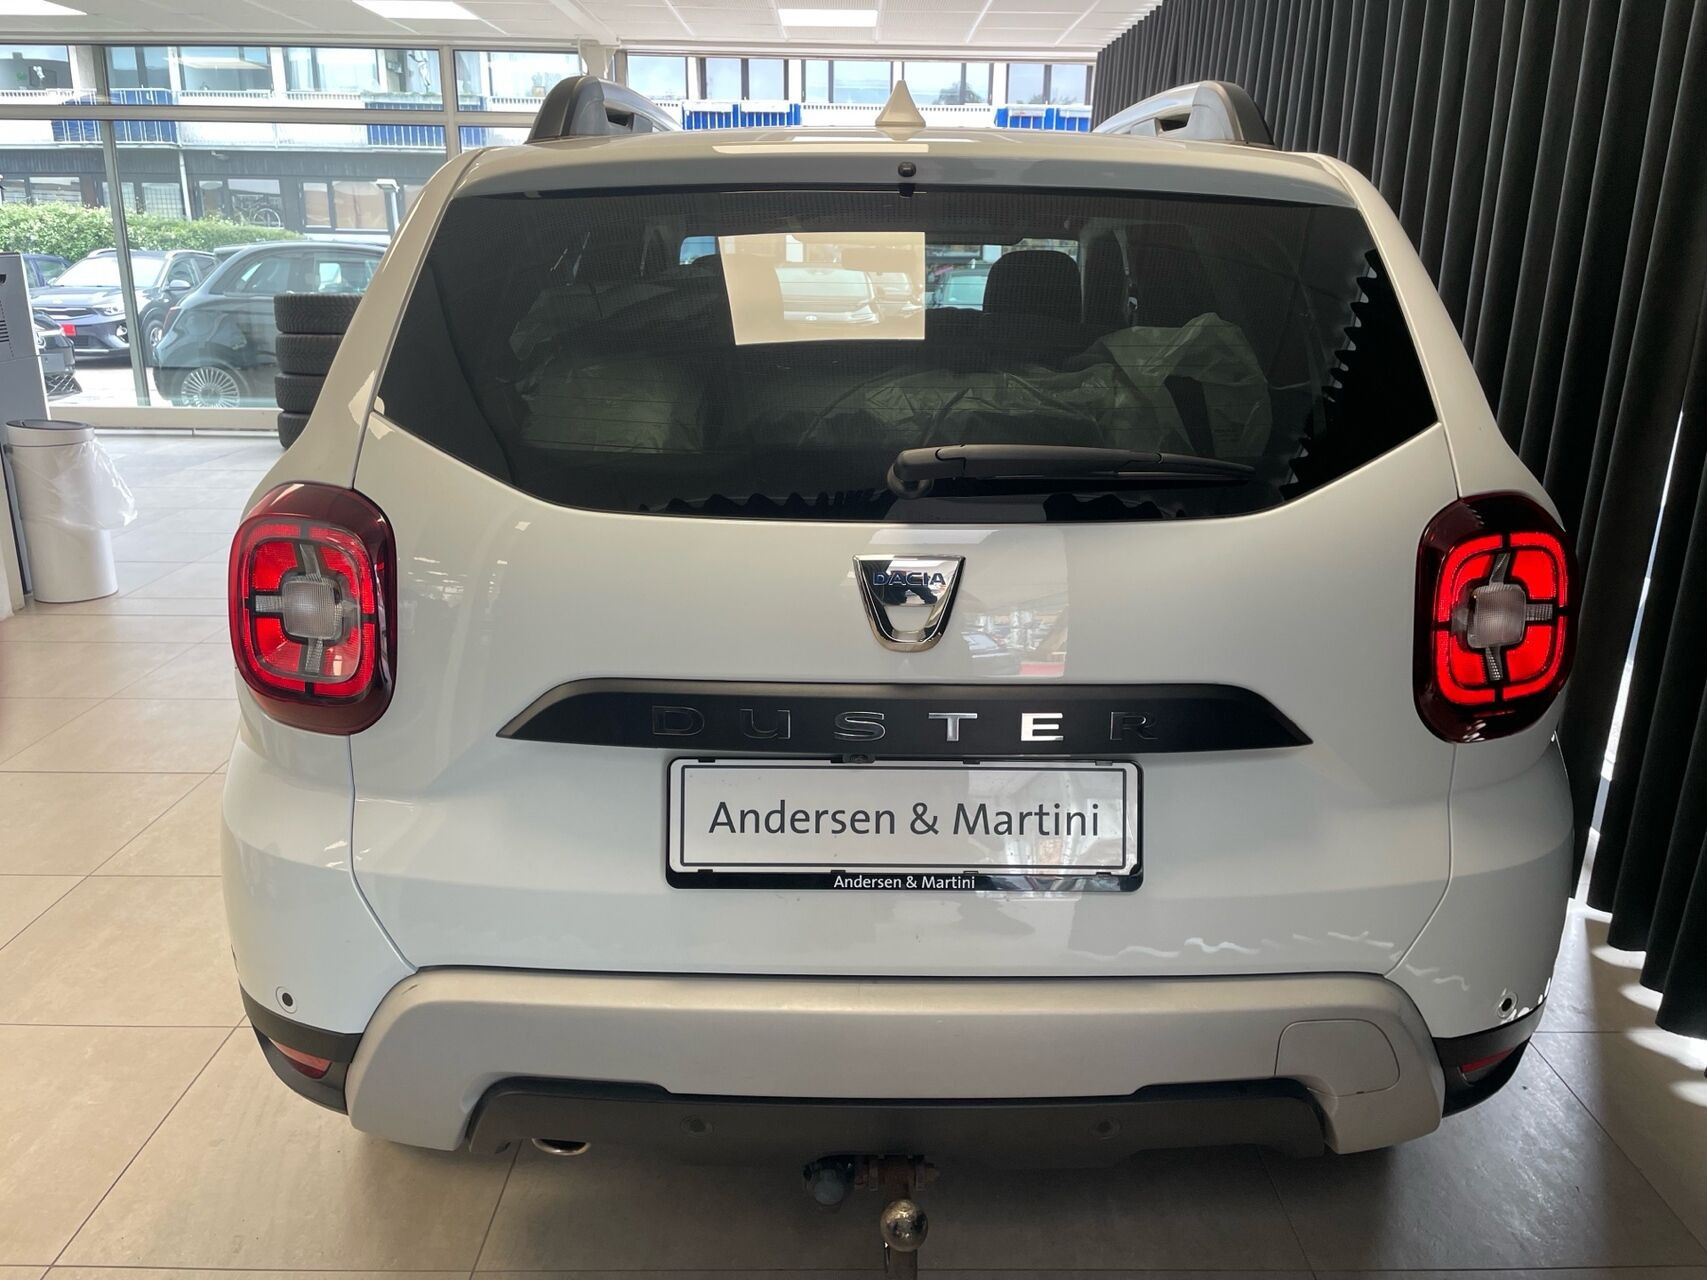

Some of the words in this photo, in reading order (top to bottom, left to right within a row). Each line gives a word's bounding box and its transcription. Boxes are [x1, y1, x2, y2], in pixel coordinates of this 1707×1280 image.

[872, 571, 947, 586] DACIA
[651, 705, 1159, 742] DUSTER
[708, 800, 896, 836] Andersen
[909, 803, 939, 836] &
[952, 803, 1100, 837] Martini
[833, 874, 901, 889] Andersen
[906, 876, 918, 889] &
[921, 875, 976, 890] Martini
